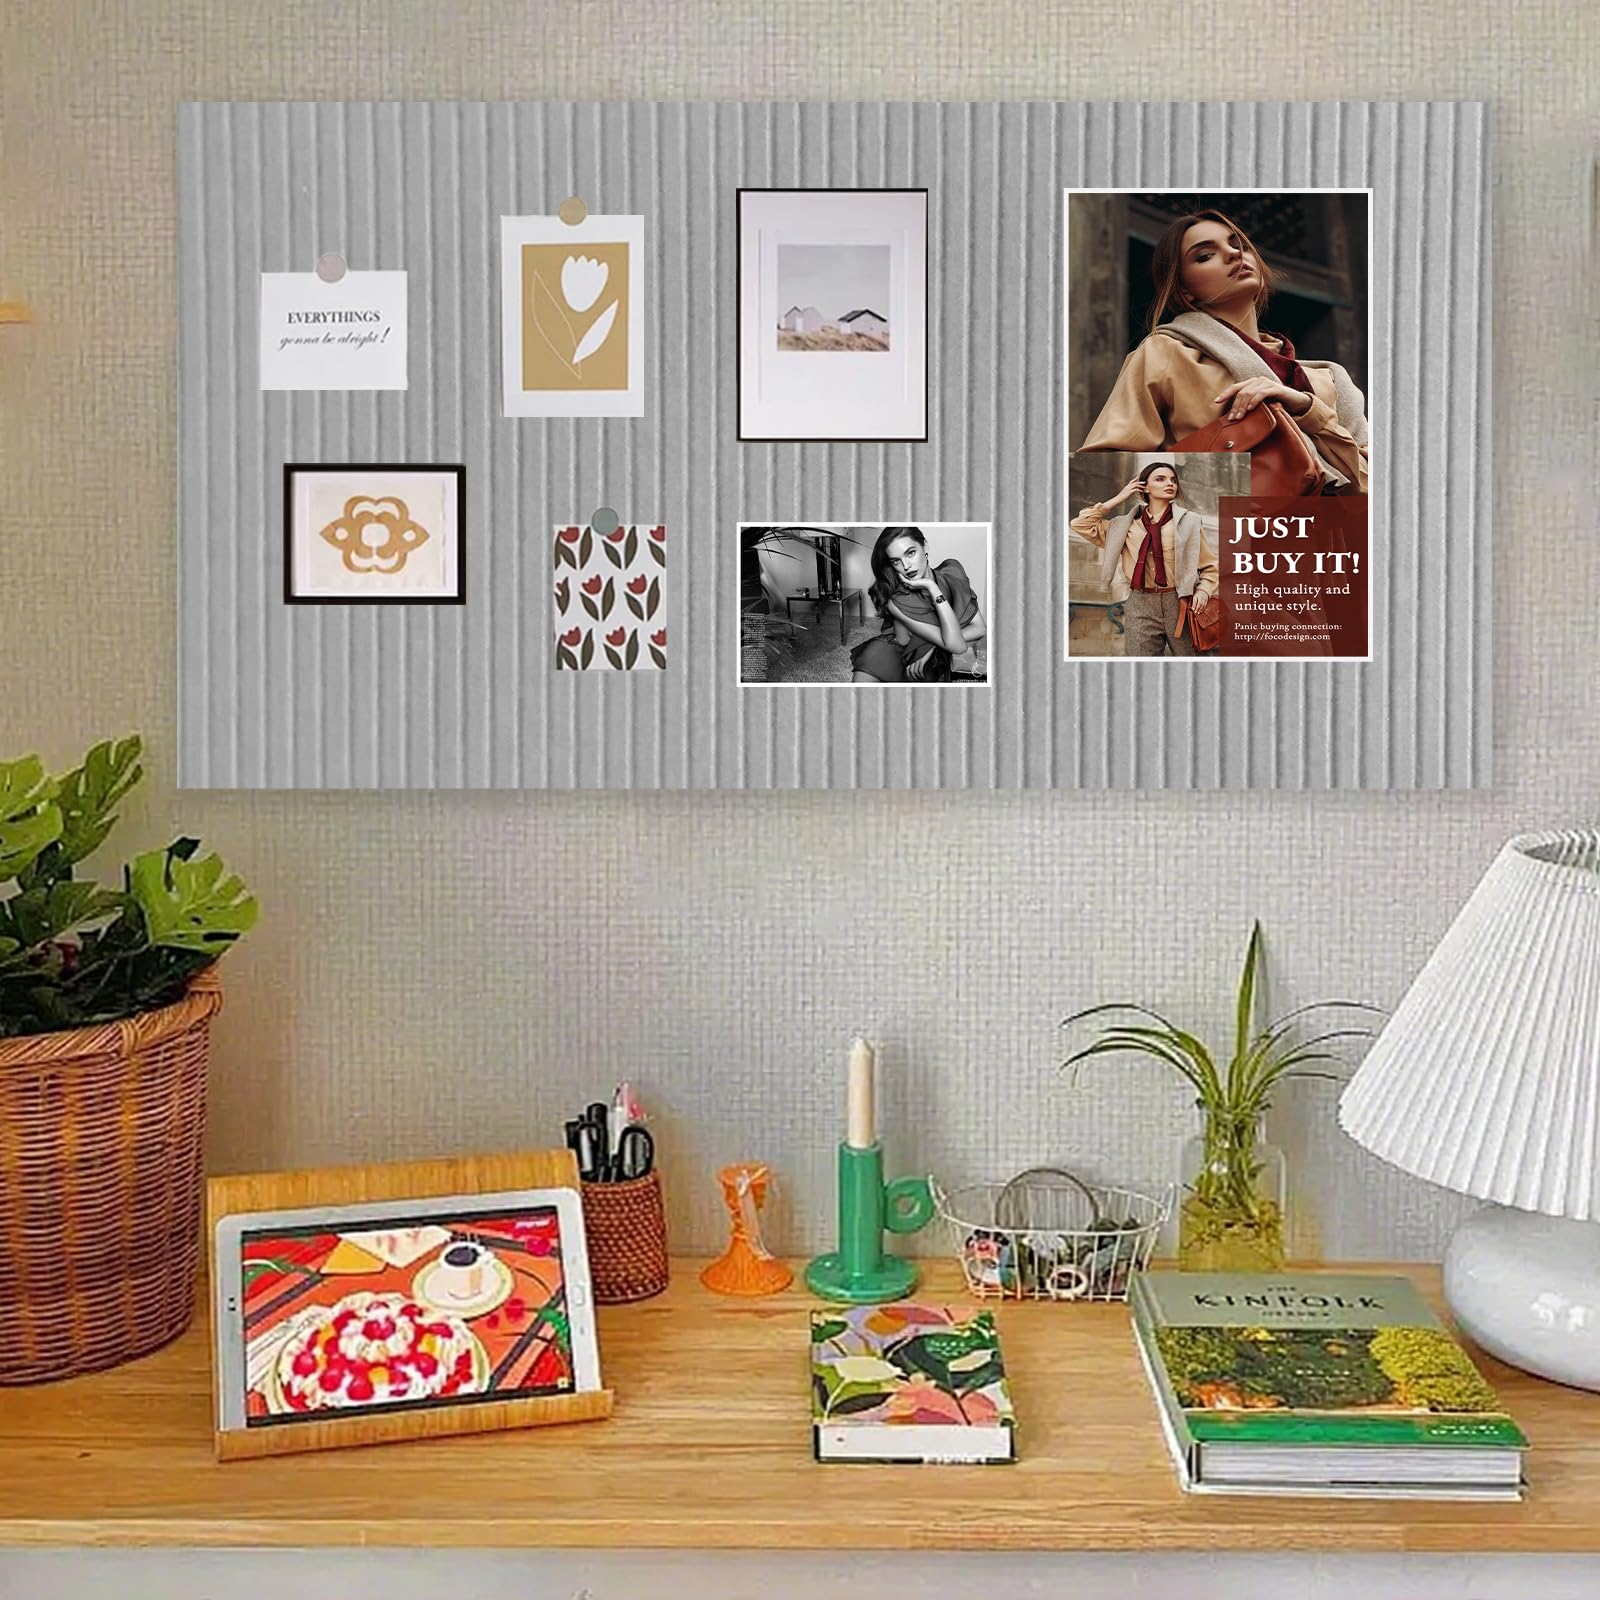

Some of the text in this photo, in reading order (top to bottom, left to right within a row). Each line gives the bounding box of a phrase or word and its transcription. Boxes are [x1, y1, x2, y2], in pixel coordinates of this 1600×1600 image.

[287, 310, 382, 324] EVERYTHINGS
[278, 337, 320, 352] gonna
[322, 331, 336, 344] be
[1228, 515, 1315, 544] JUST
[1232, 551, 1360, 574] BUY IT!
[1235, 583, 1351, 598] High quality and
[1235, 600, 1322, 615] unique style.
[1234, 622, 1343, 633] Panic buying connection:
[1234, 632, 1331, 642] http://focodesign.com
[1194, 1294, 1384, 1309] KINFOLK
